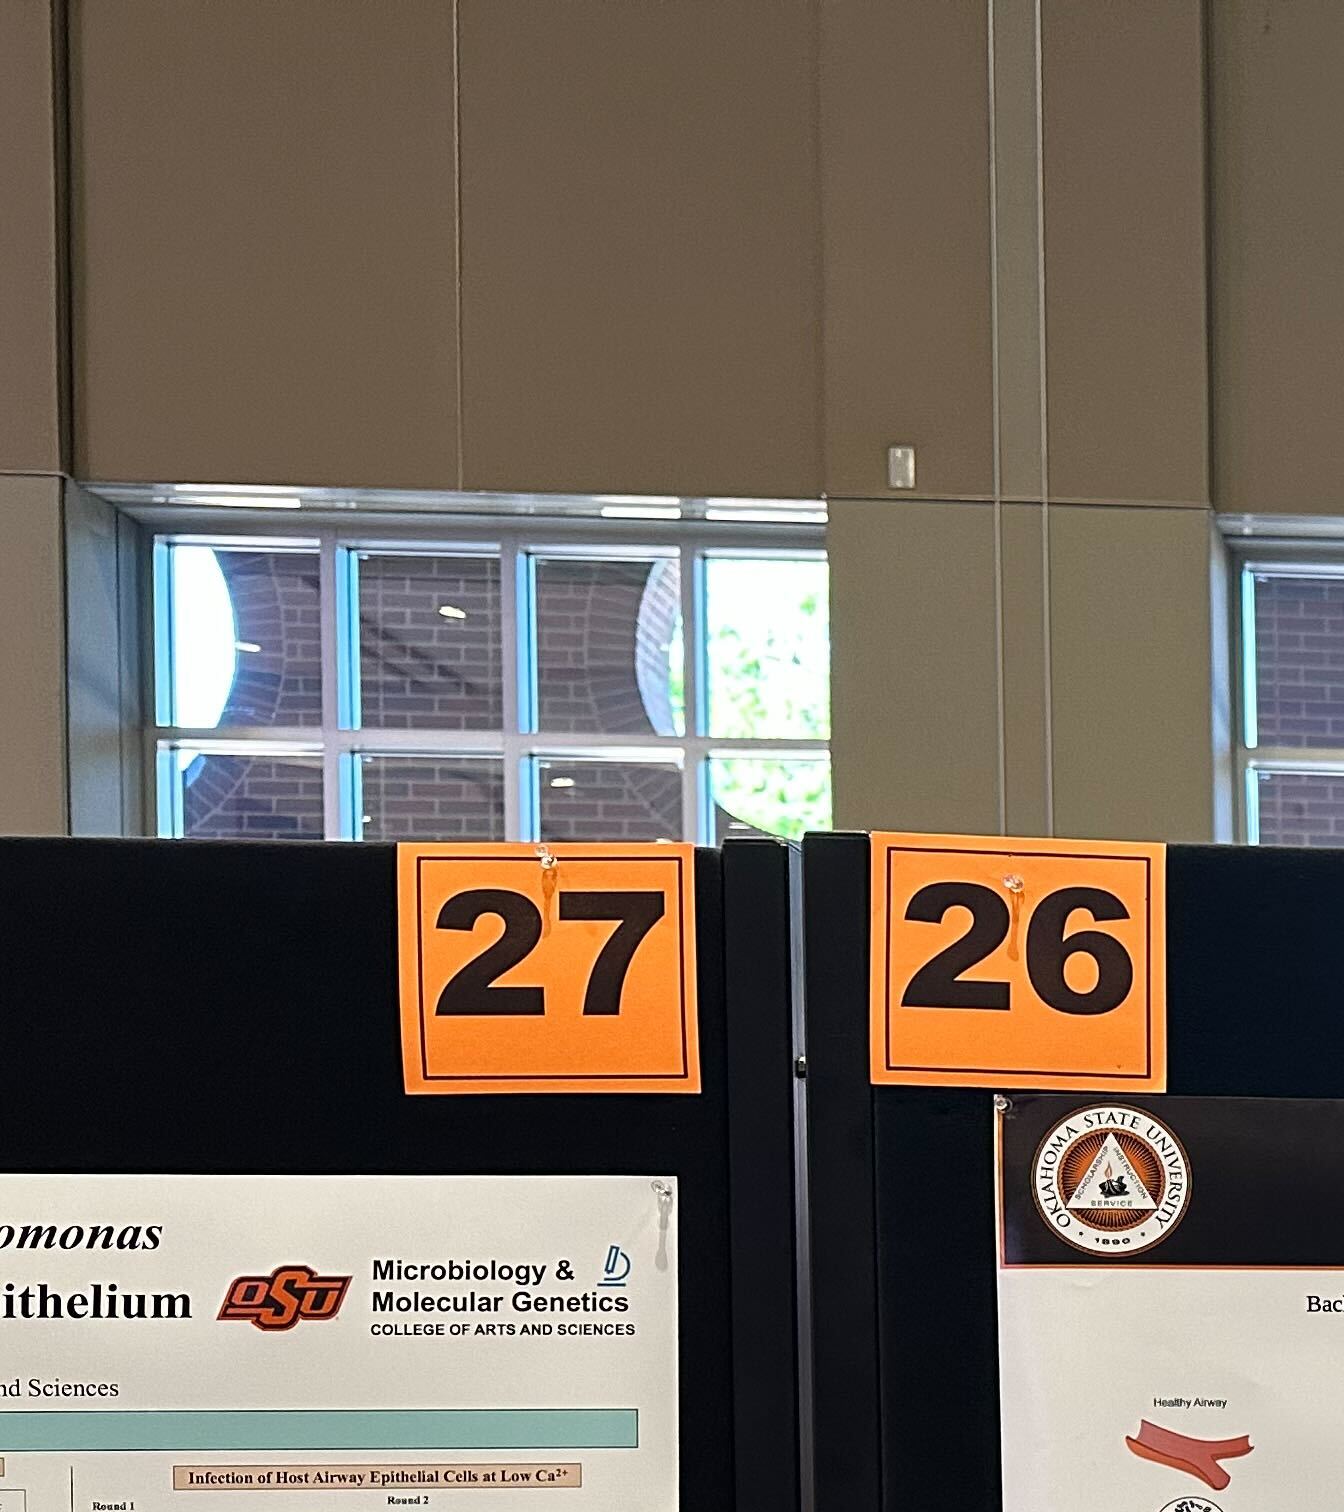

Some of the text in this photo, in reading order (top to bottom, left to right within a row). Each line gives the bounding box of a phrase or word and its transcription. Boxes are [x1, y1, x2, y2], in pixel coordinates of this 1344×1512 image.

[436, 888, 664, 1016] 27
[901, 882, 1134, 1016] 26
[1039, 1111, 1183, 1230] OKLAHOMA STATE UNIVERSITY
[372, 1259, 575, 1286] Microbiology &
[215, 1264, 354, 1332] OSU
[372, 1291, 629, 1313] Molecular Genetics
[370, 1323, 636, 1336] COLLEGE OF ARTS AND SCIENCES
[28, 1377, 119, 1398] Sciences
[187, 1470, 254, 1485] Infection
[256, 1470, 274, 1485] of
[275, 1470, 310, 1485] Host
[312, 1469, 367, 1487] Airway
[369, 1469, 440, 1486] Epithelial
[442, 1469, 479, 1484] Cells
[482, 1471, 497, 1484] at
[500, 1469, 532, 1483] Low
